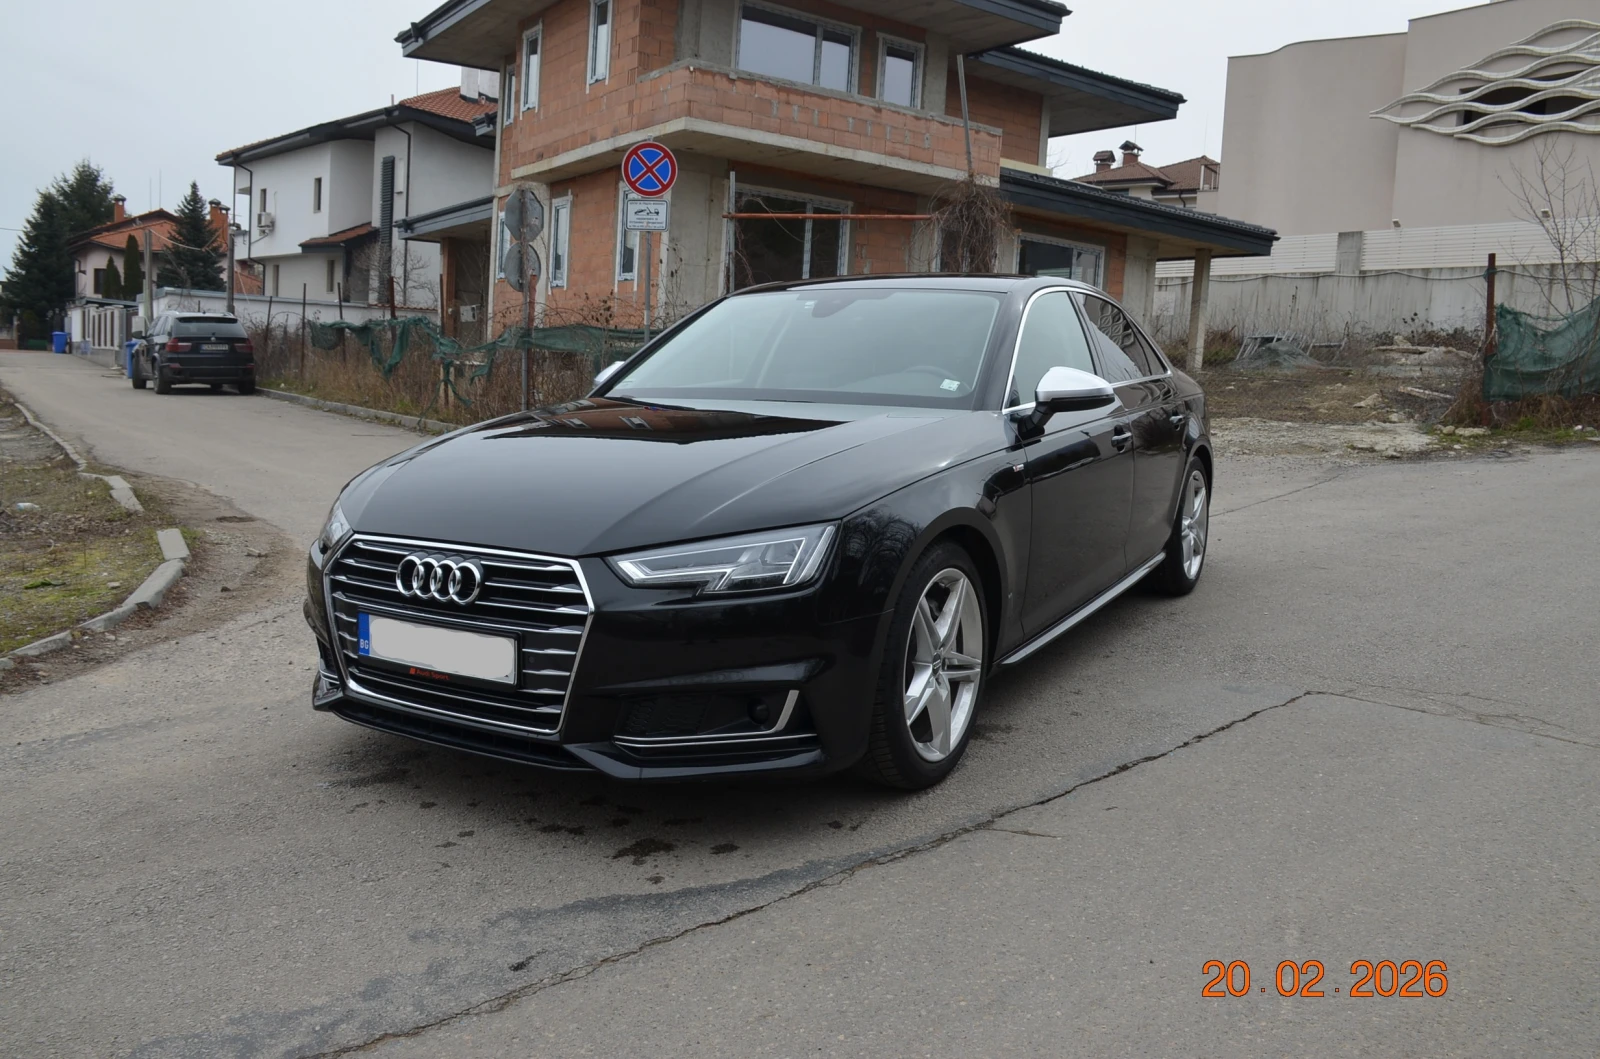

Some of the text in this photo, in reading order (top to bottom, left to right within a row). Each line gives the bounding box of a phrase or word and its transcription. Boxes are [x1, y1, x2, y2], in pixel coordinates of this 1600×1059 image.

[360, 638, 369, 650] BG
[416, 668, 449, 680] Audi Sport
